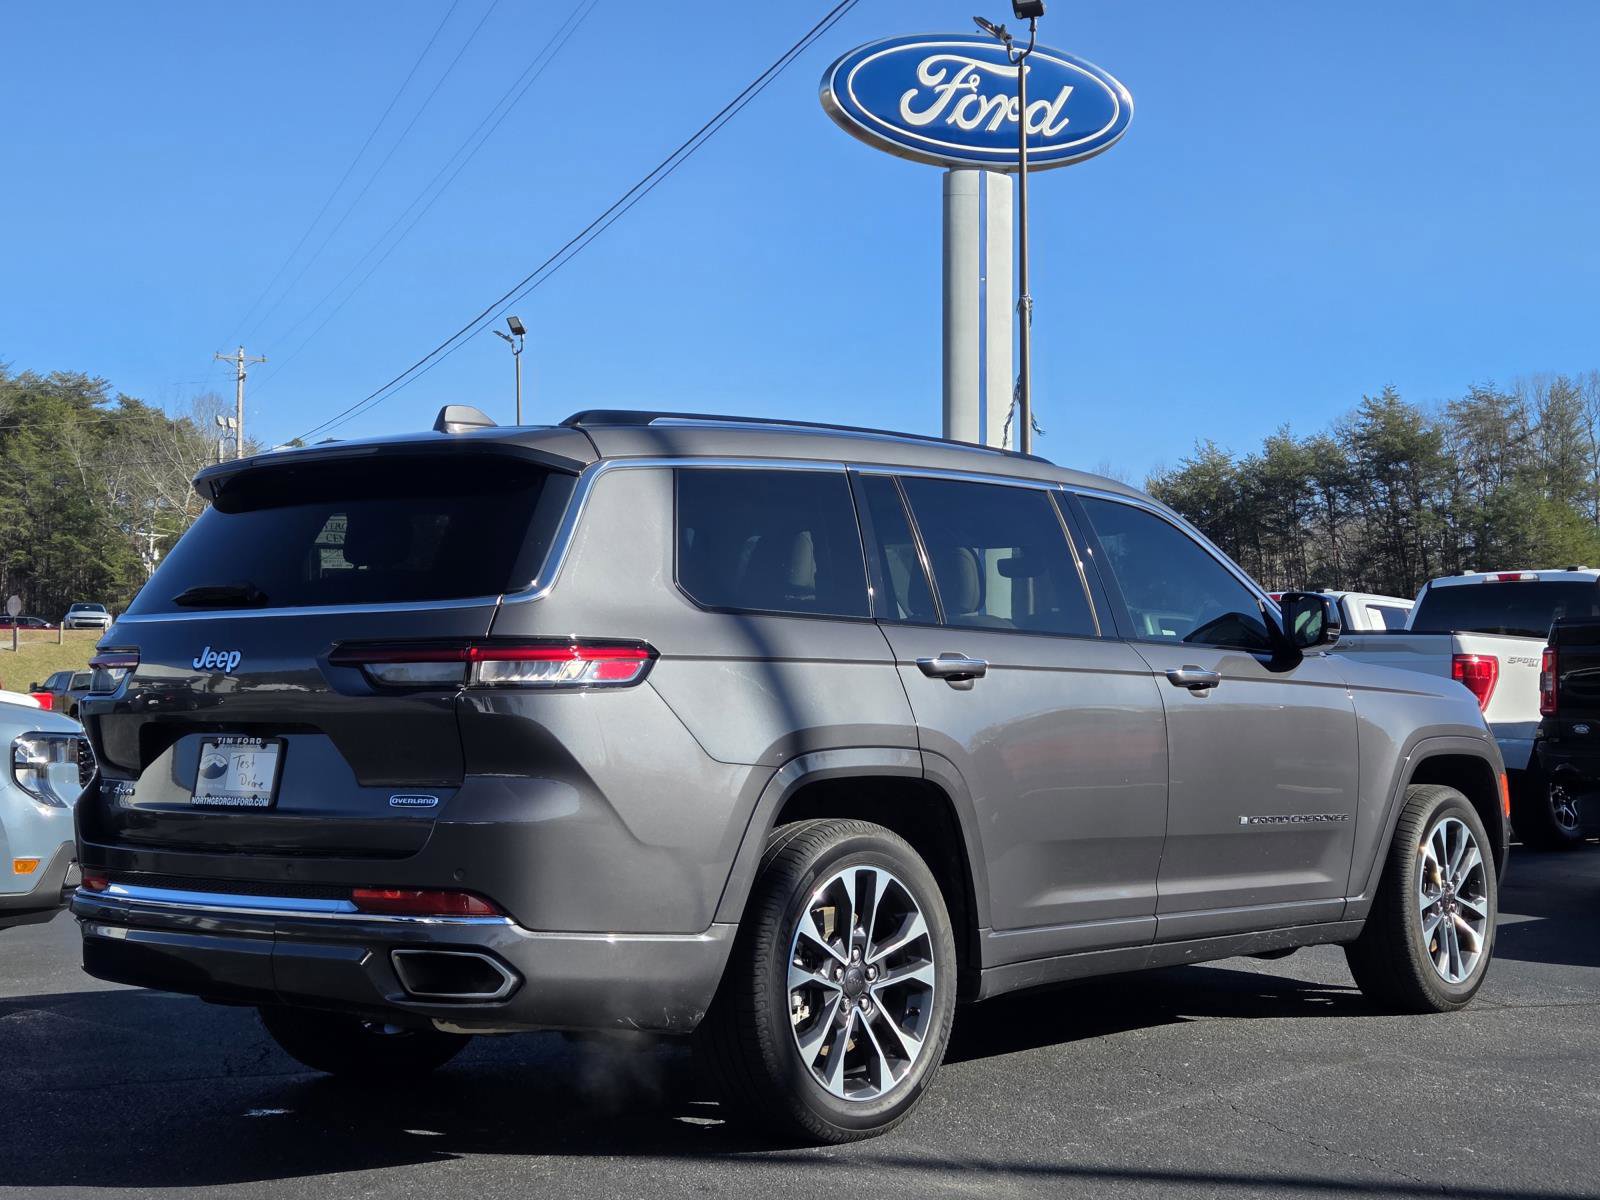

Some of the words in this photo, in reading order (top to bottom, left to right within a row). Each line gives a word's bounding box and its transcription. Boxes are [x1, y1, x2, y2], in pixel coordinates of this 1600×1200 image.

[899, 54, 1074, 137] Ford
[192, 646, 241, 673] Jeep
[217, 737, 233, 745] TIM
[237, 737, 262, 745] FORD
[232, 753, 255, 771] Test
[191, 796, 269, 807] NORTHGEORGIAFORD.COM
[391, 797, 435, 805] OVERLAND
[1290, 813, 1350, 824] CHEROKEE
